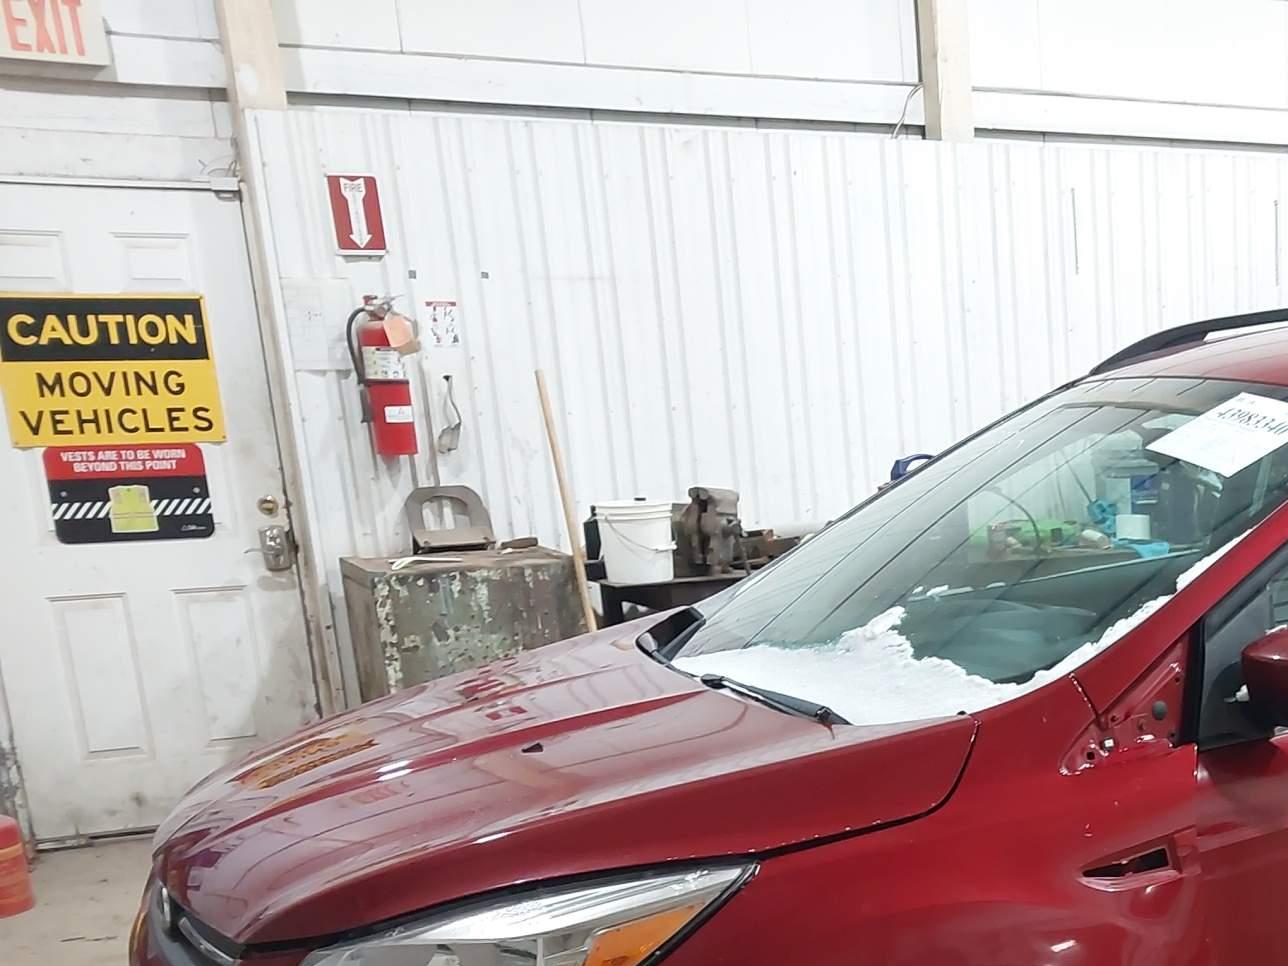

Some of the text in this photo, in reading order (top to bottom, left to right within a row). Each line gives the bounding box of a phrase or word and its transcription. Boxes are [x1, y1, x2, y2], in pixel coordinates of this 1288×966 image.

[2, 0, 86, 56] EXIT
[343, 182, 364, 193] FIRE
[7, 313, 198, 346] CAUTION
[35, 370, 186, 398] MOVING
[19, 406, 214, 436] VEHICLES
[60, 448, 186, 462] VESTS ARE TO BE WORN
[73, 459, 177, 473] BEYOND THIS POINT
